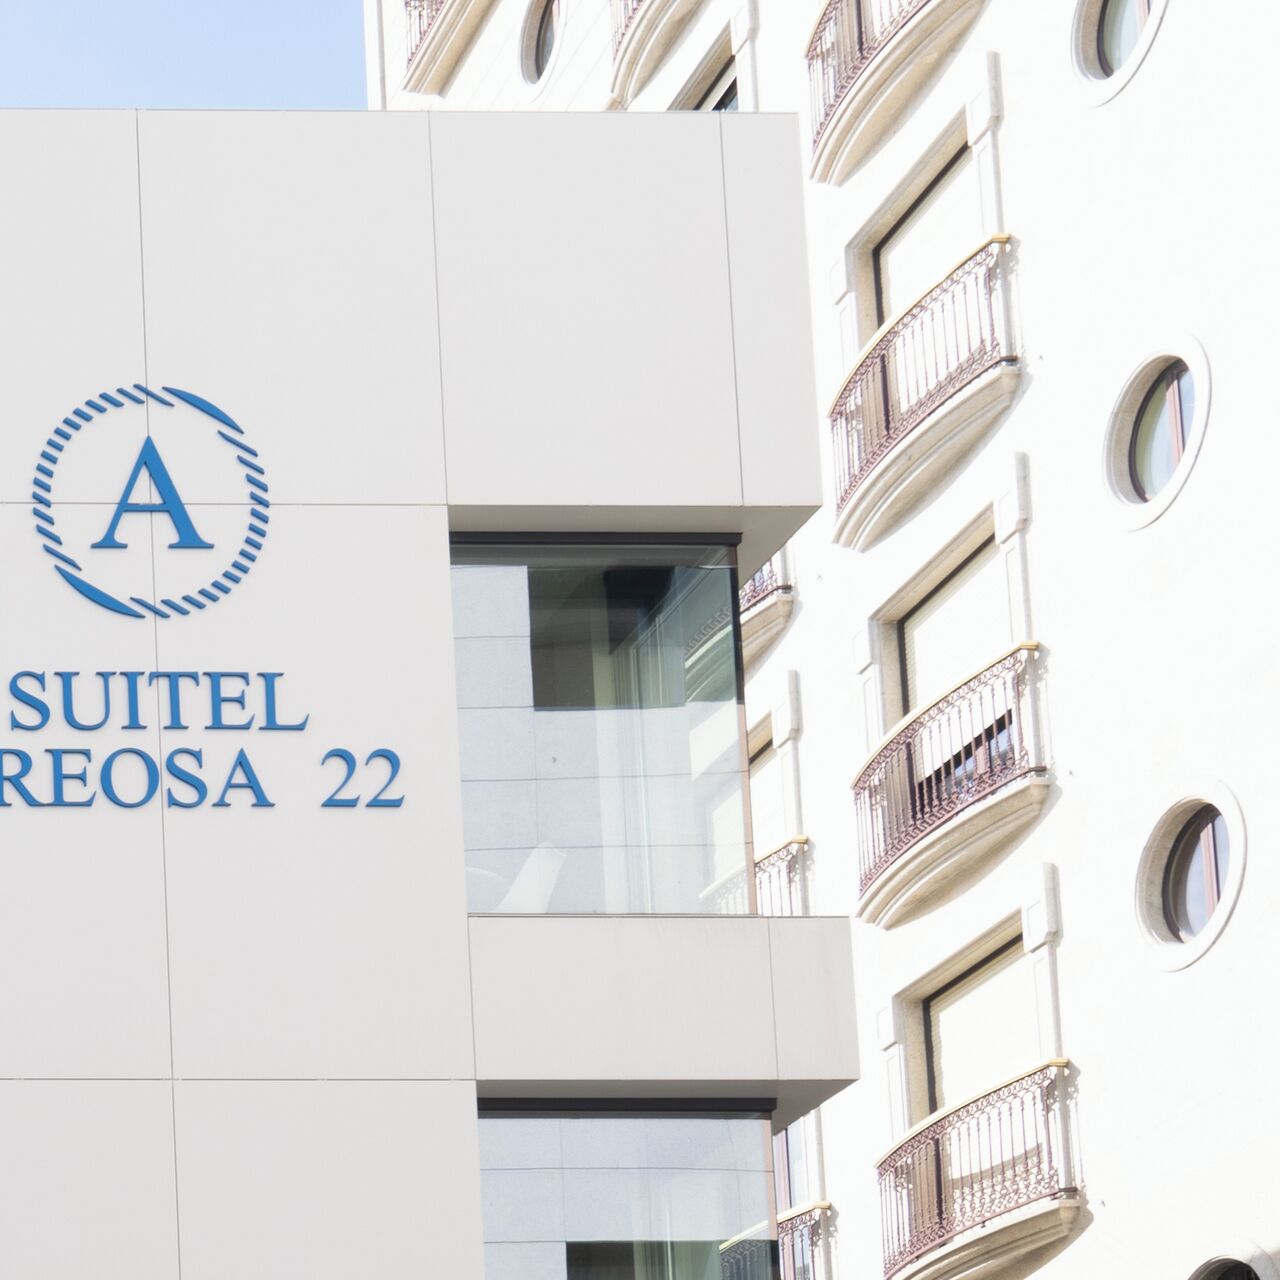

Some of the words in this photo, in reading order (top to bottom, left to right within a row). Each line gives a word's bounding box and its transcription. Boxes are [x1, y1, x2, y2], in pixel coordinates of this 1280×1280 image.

[90, 435, 215, 550] A
[8, 670, 310, 731] SUITEL
[320, 747, 406, 808] 22
